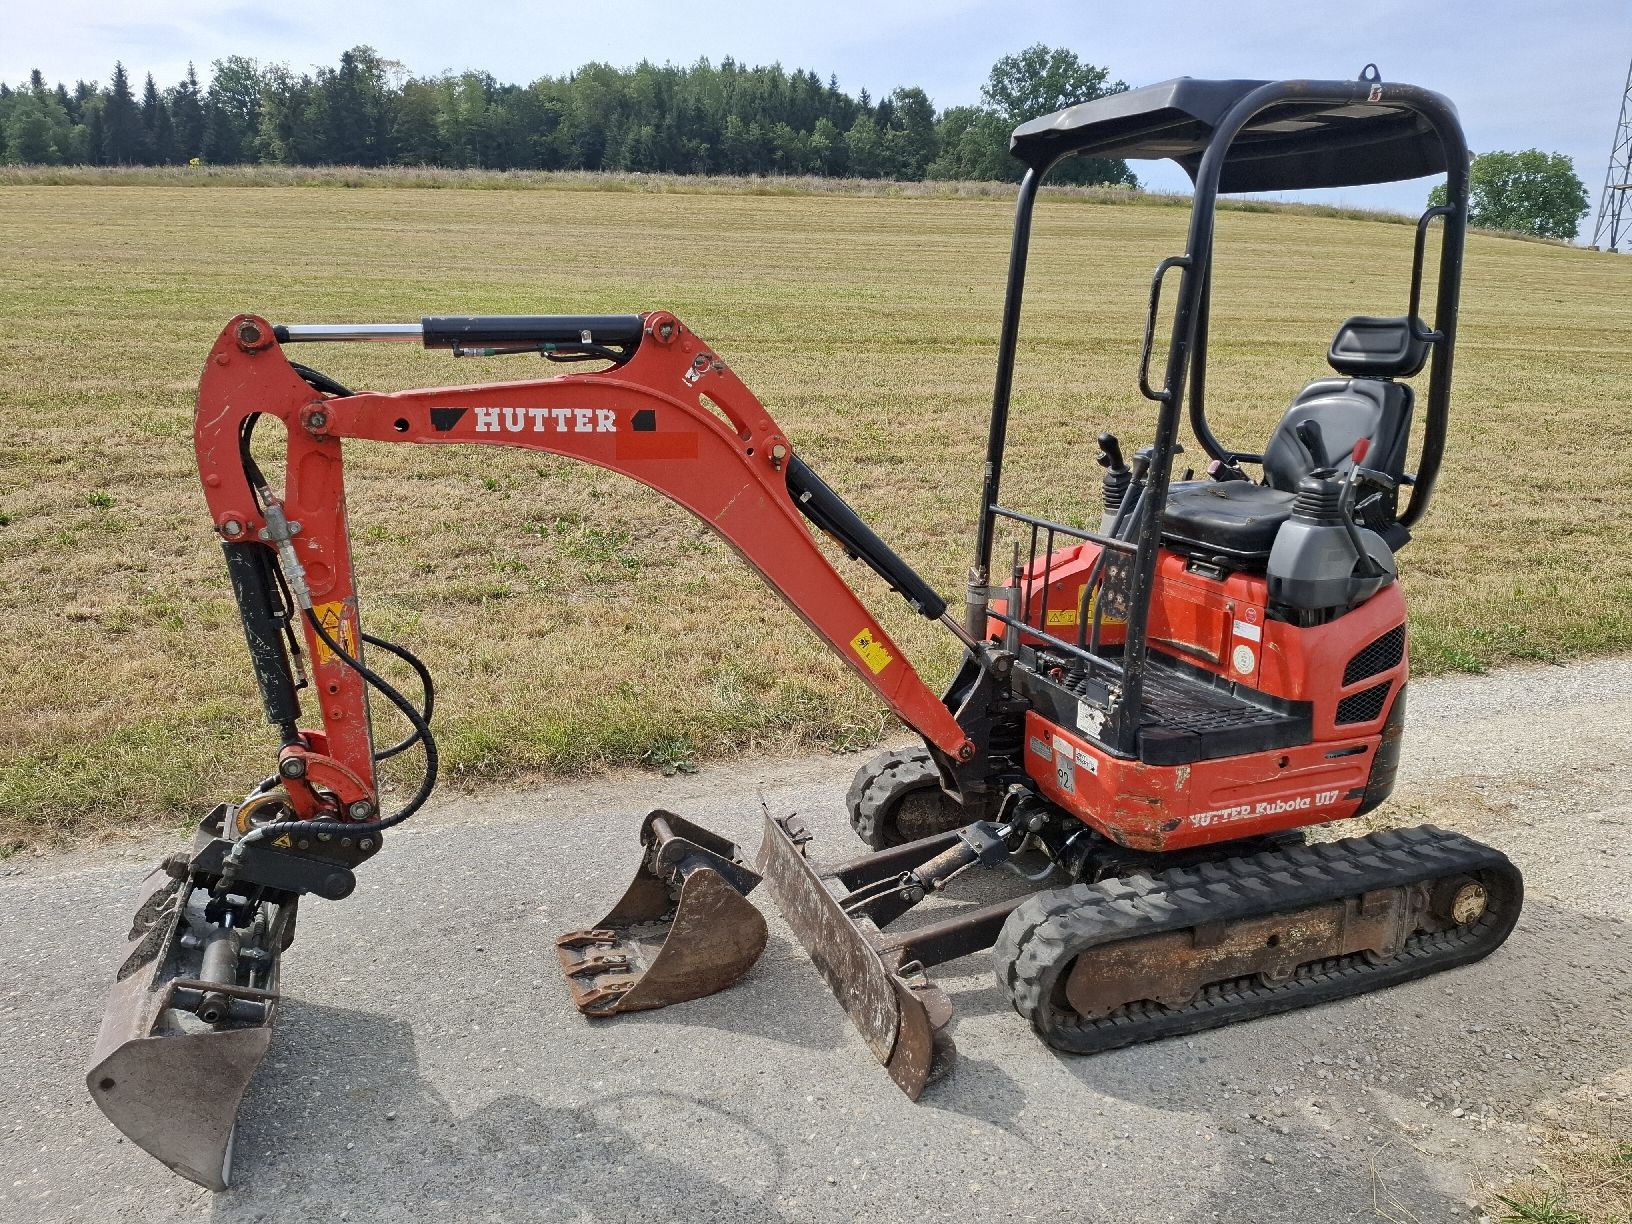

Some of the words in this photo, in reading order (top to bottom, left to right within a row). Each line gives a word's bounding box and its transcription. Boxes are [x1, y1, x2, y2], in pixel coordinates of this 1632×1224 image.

[474, 407, 617, 432] HUTTER
[1256, 797, 1311, 815] Kubota
[1315, 789, 1340, 806] U17
